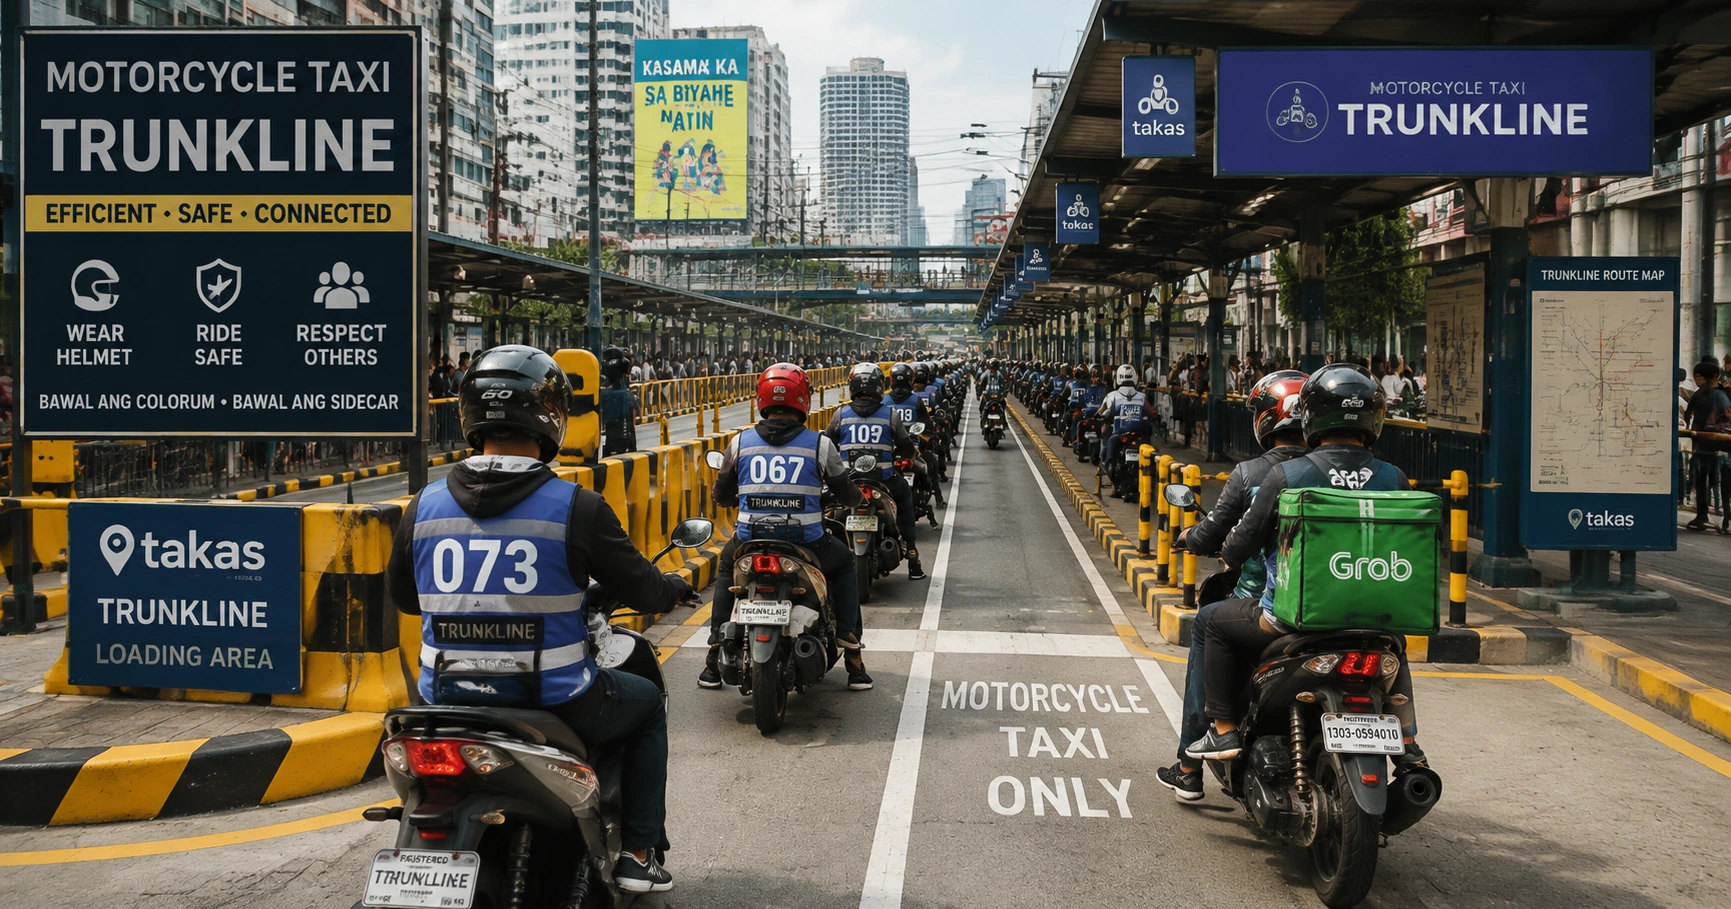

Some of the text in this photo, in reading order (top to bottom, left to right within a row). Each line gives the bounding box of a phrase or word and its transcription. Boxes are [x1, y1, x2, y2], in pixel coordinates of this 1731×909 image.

[47, 61, 390, 93] MOTORCYCLE TAXI
[716, 59, 739, 75] KA
[645, 85, 667, 106] SA
[1370, 82, 1525, 95] MOTORCYCLE TAXI
[661, 110, 714, 132] NATIN
[1132, 120, 1185, 135] takas
[1338, 103, 1588, 135] TRUNKLINE
[41, 119, 395, 172] TRUNKLINE
[46, 203, 392, 223] EFFICIENT SAFE CONNECTED
[1541, 270, 1665, 281] TRUNKLINE ROUTE MAP
[66, 324, 124, 342] WEAR
[196, 324, 242, 342] RIDE
[297, 324, 387, 342] RESPECT
[57, 348, 132, 366] HELMET
[195, 348, 243, 366] SAFE
[304, 348, 378, 366] OTHERS
[39, 394, 399, 410] BAWAL ANG COLORUM BAWAL ANG SIDECAR
[750, 455, 804, 484] 067
[1586, 510, 1634, 526] takas
[141, 530, 266, 570] takas
[433, 538, 538, 594] 073
[1329, 551, 1413, 582] Grab
[98, 598, 268, 628] TRUNKLINE
[439, 623, 535, 640] TRUNKLINE
[96, 643, 274, 669] LOADING AREA
[941, 681, 1149, 713] MOTORCYCLE
[999, 727, 1109, 759] TAXI
[988, 775, 1133, 818] ONLY
